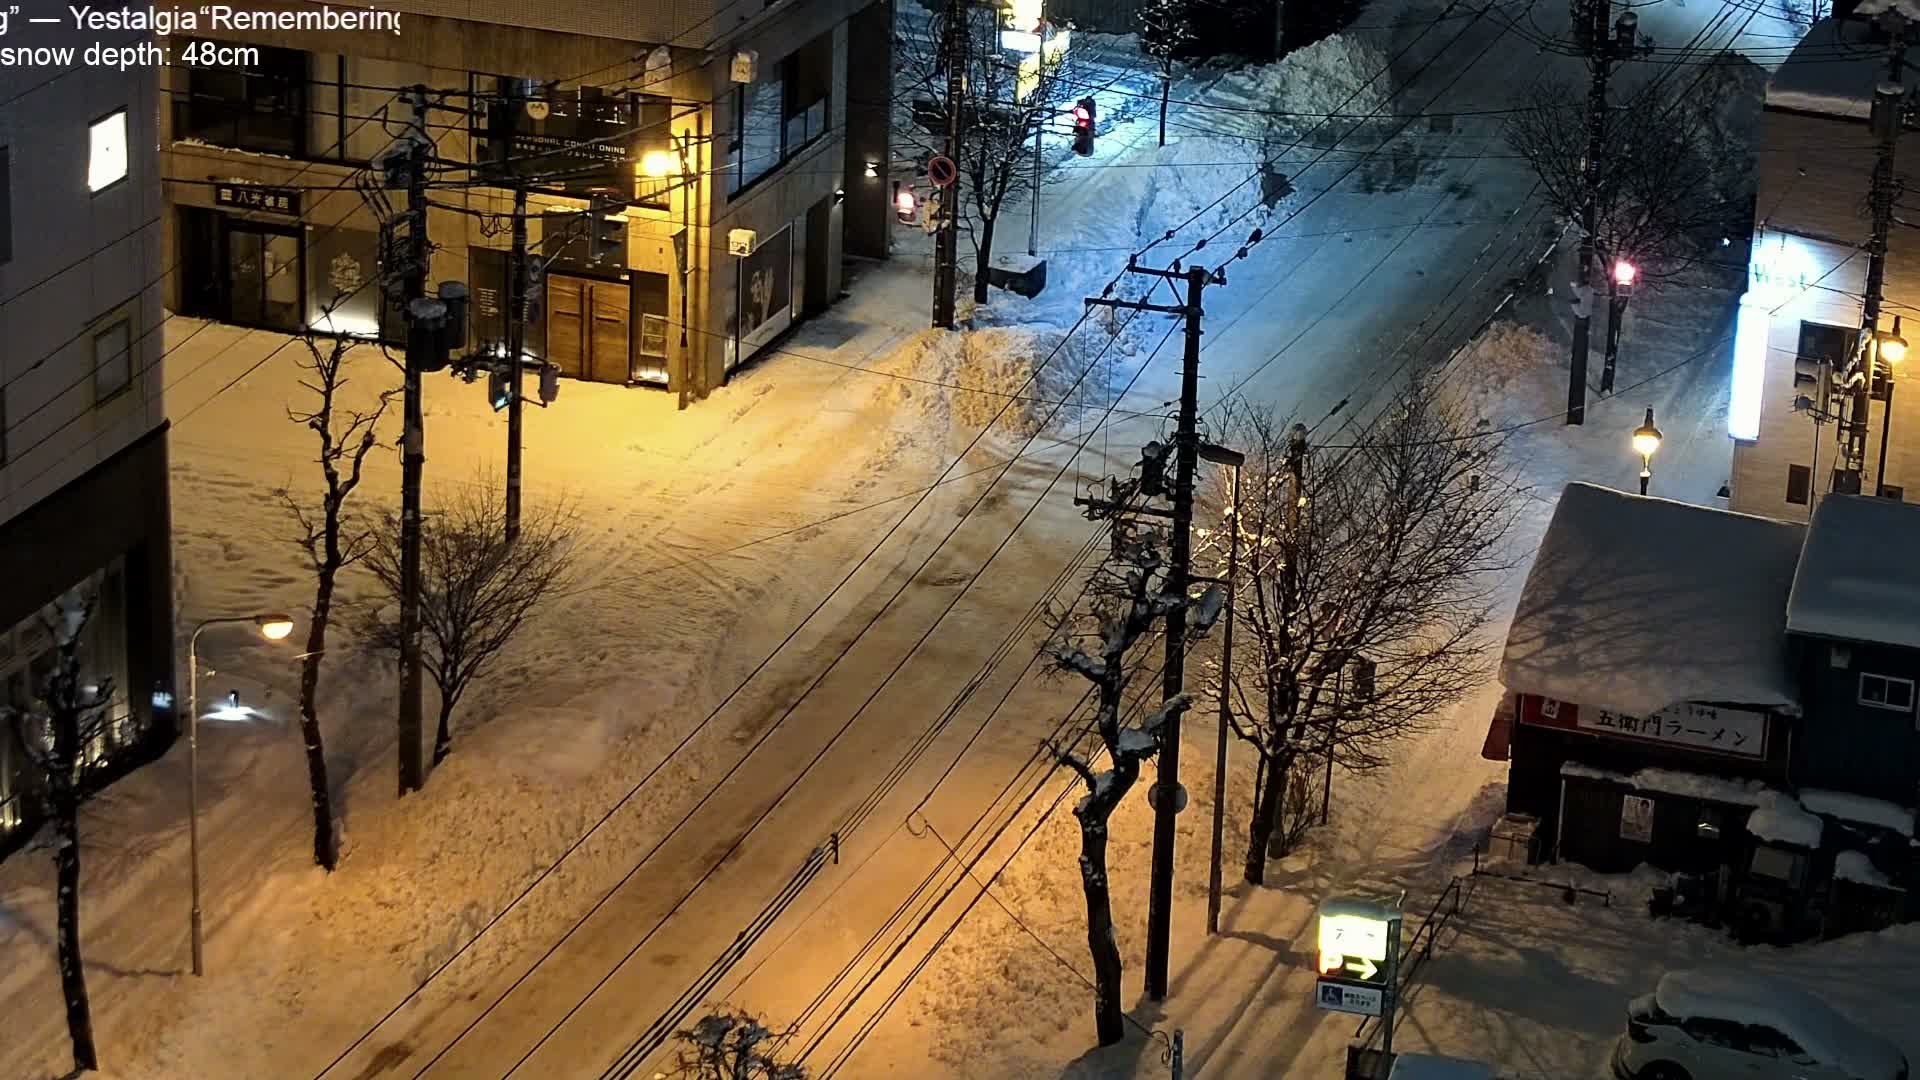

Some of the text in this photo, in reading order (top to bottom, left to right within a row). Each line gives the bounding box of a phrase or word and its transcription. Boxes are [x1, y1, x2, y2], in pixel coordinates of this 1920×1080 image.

[1596, 710, 1750, 747] 五衛門ラーメン
